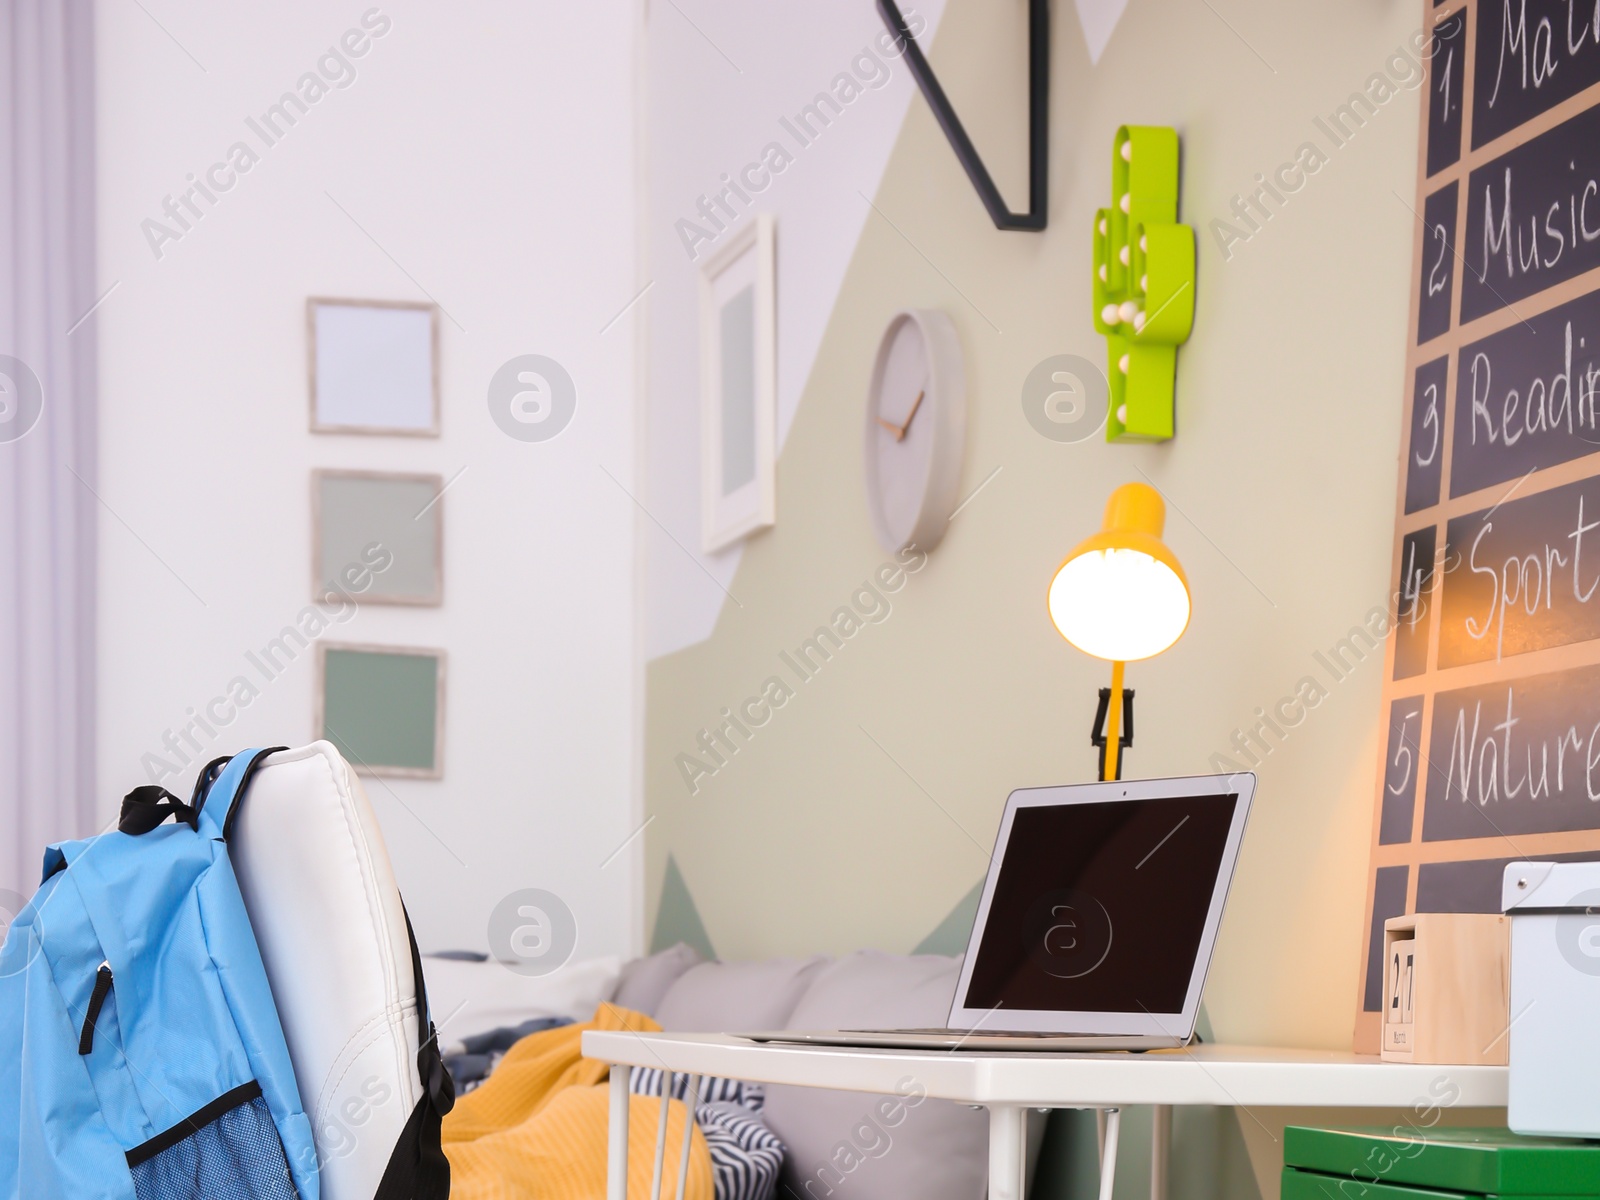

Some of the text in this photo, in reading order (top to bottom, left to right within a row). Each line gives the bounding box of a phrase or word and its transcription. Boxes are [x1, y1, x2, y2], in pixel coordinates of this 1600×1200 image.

[1428, 159, 1600, 297] 2 Music
[1415, 383, 1440, 468] 3
[1404, 494, 1600, 667] 4 Sport
[1387, 710, 1420, 796] 5
